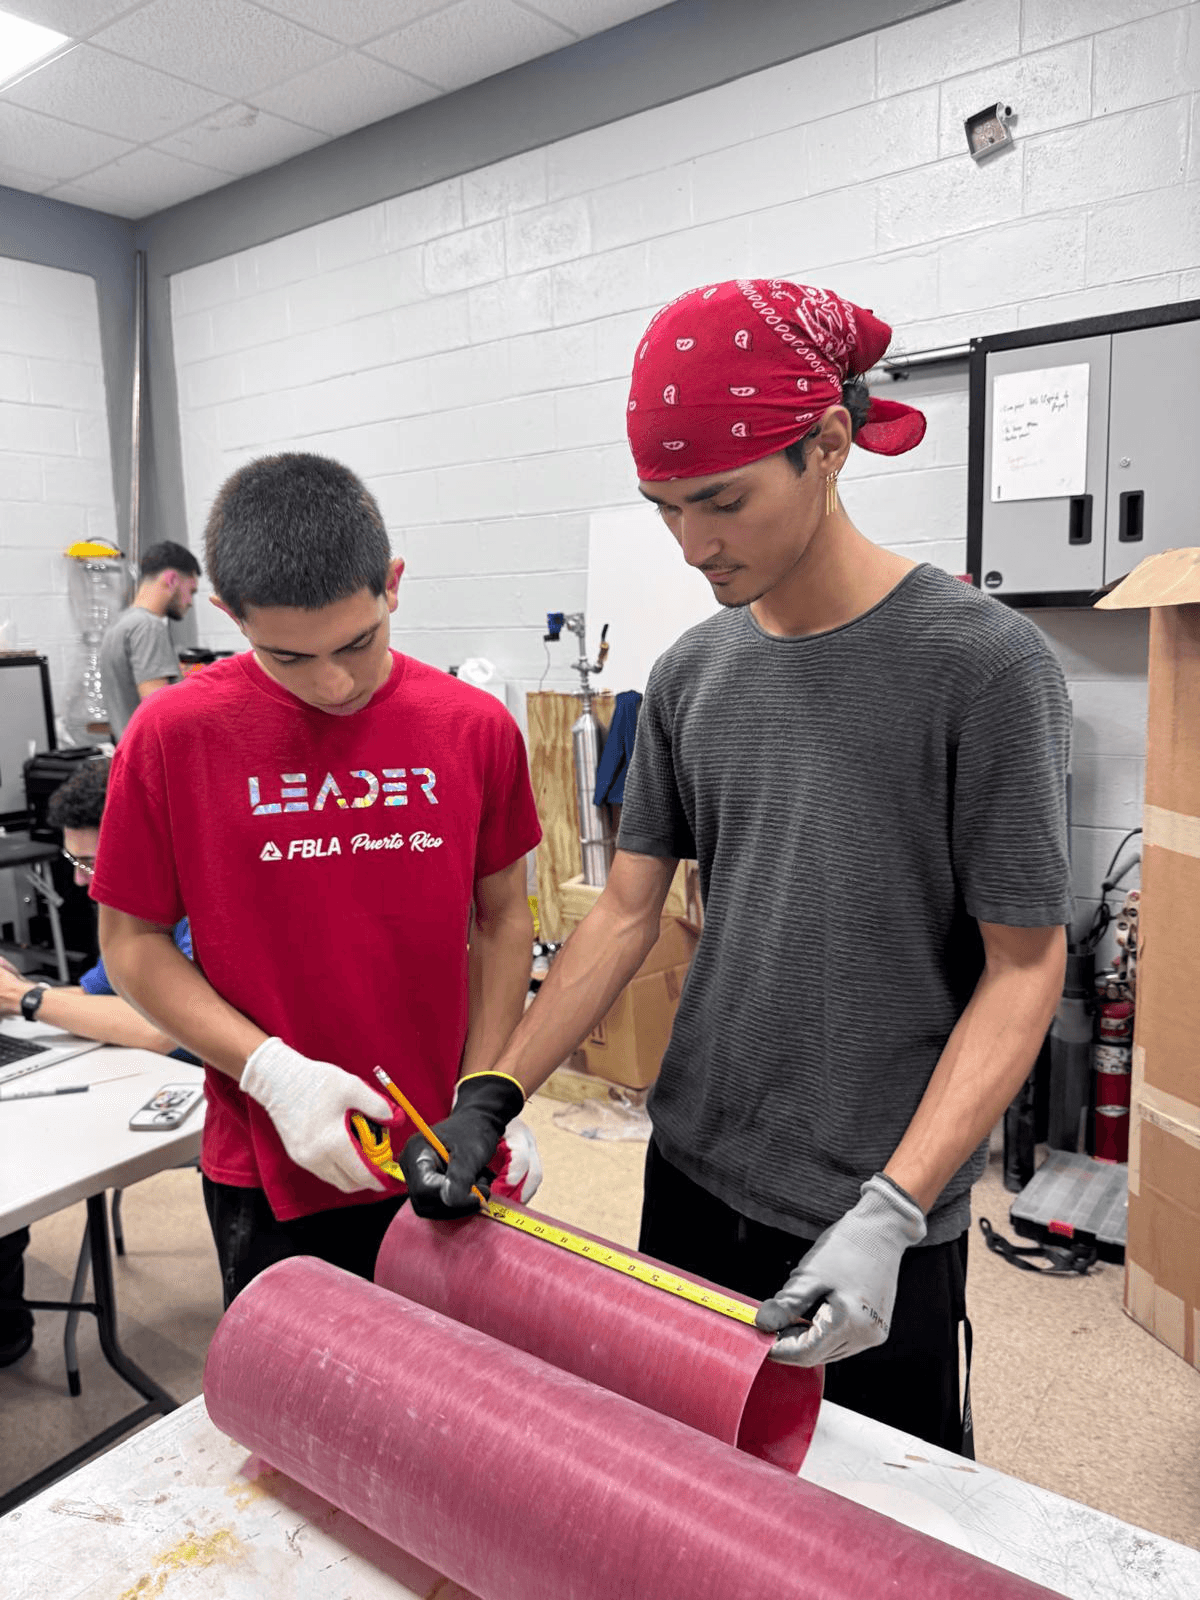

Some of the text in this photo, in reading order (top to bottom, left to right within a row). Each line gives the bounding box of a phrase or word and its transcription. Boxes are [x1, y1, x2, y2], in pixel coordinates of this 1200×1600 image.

[248, 768, 439, 815] LEADER
[287, 831, 443, 860] FBLA Puerto Rico
